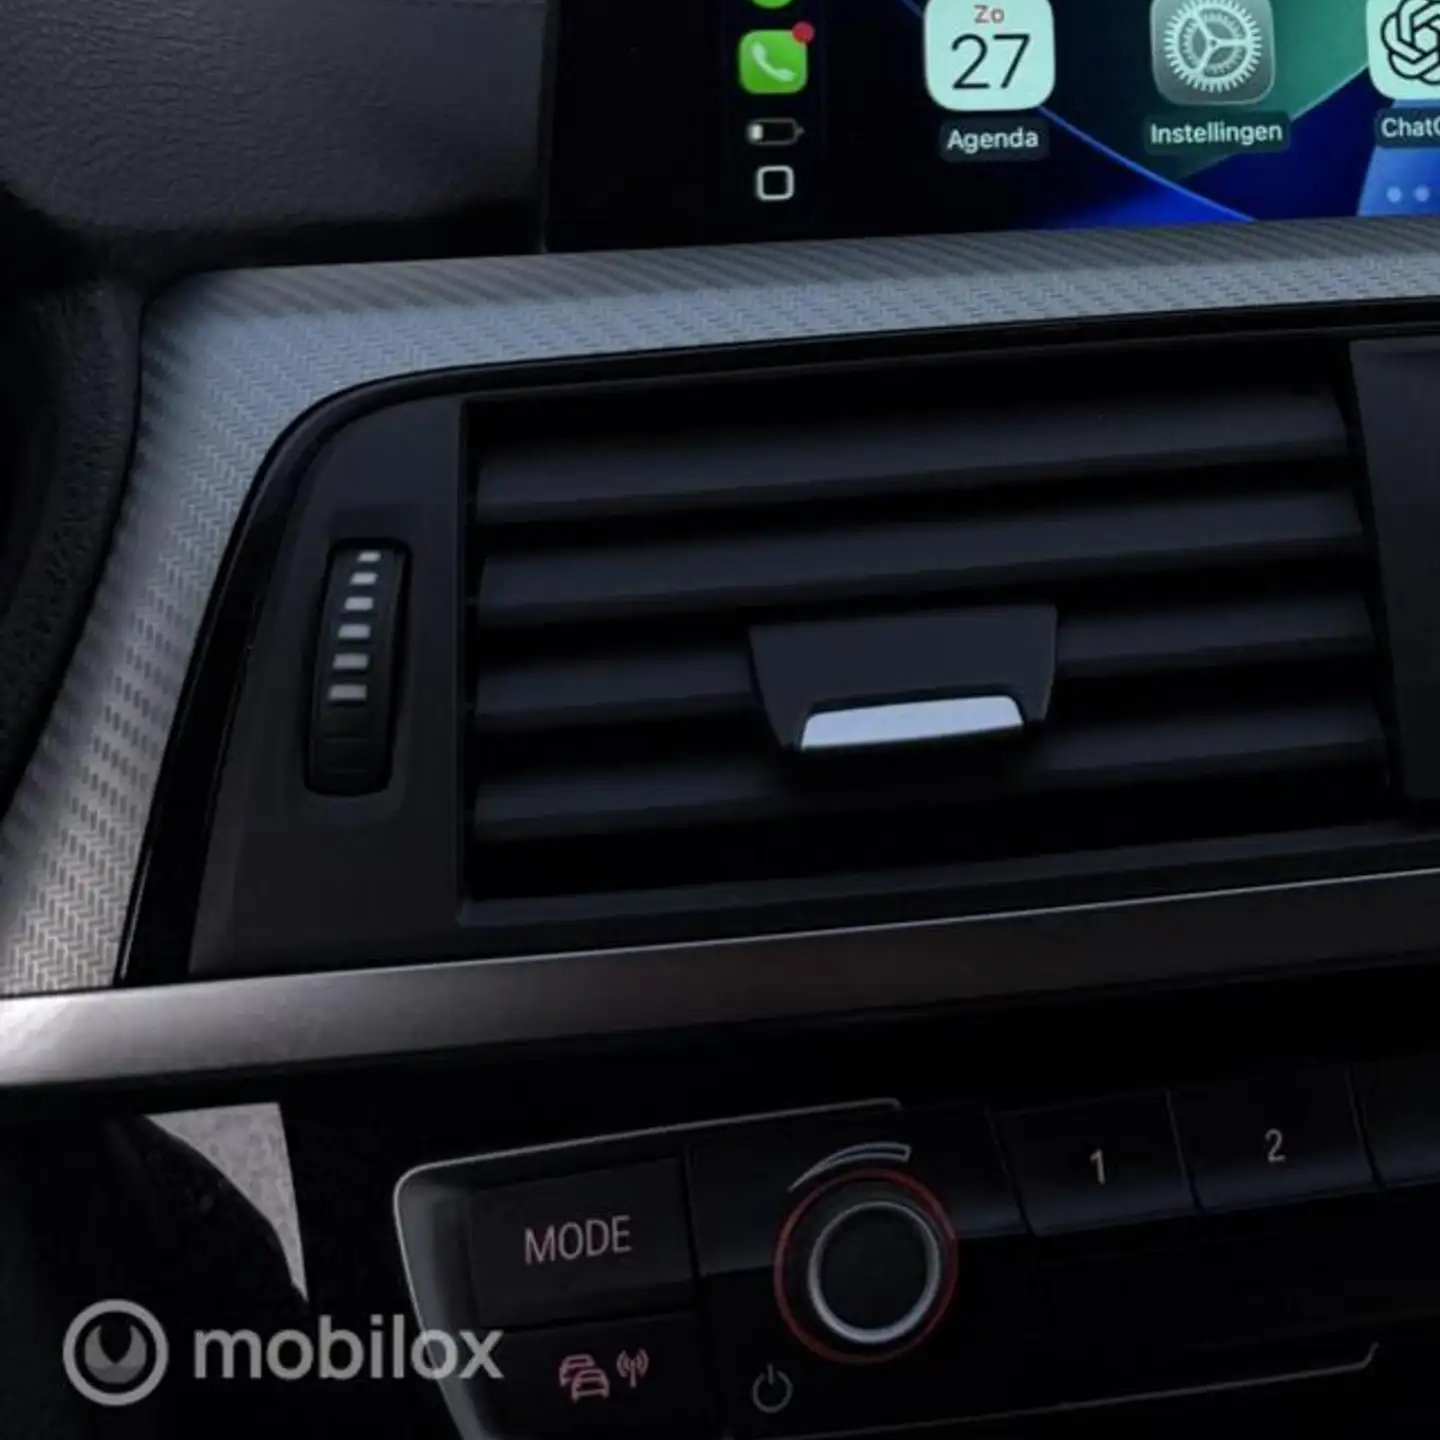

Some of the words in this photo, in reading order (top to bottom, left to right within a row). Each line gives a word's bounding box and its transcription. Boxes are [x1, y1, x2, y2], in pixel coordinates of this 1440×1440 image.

[974, 5, 1005, 24] Zo
[950, 33, 1031, 90] 27
[947, 127, 1039, 152] Agenda
[1151, 122, 1283, 149] Instellingen
[1266, 1131, 1285, 1163] 2
[1089, 1150, 1108, 1184] 1
[523, 1216, 632, 1265] MODE
